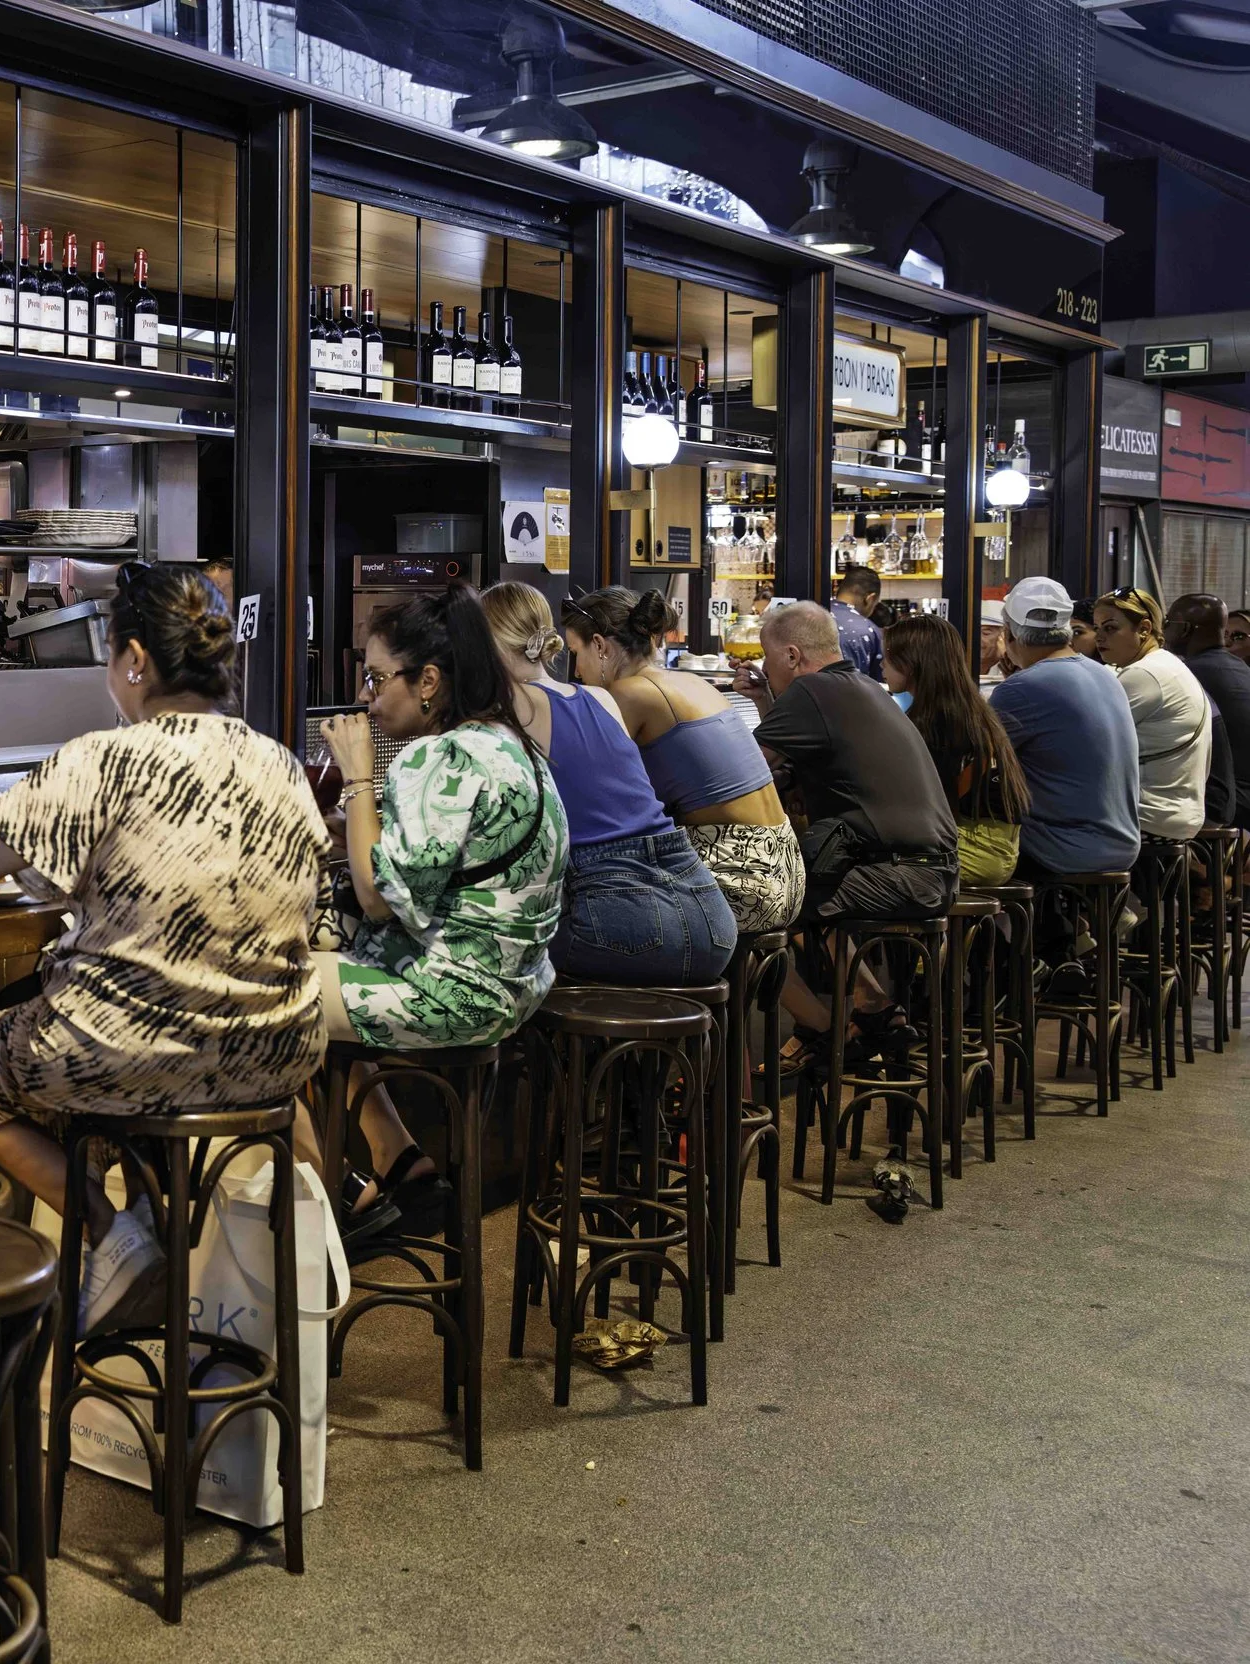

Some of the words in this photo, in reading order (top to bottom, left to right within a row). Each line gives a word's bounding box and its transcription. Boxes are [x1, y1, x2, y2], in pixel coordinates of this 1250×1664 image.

[43, 303, 62, 313] Protos
[1056, 287, 1074, 317] 218
[1080, 295, 1098, 324] 223
[859, 362, 866, 391] Y
[867, 363, 895, 397] BRASAS
[362, 563, 385, 572] mychef
[240, 602, 257, 638] 25
[711, 601, 728, 615] 50
[93, 1431, 113, 1449] 100%
[114, 1439, 149, 1460] RECYC
